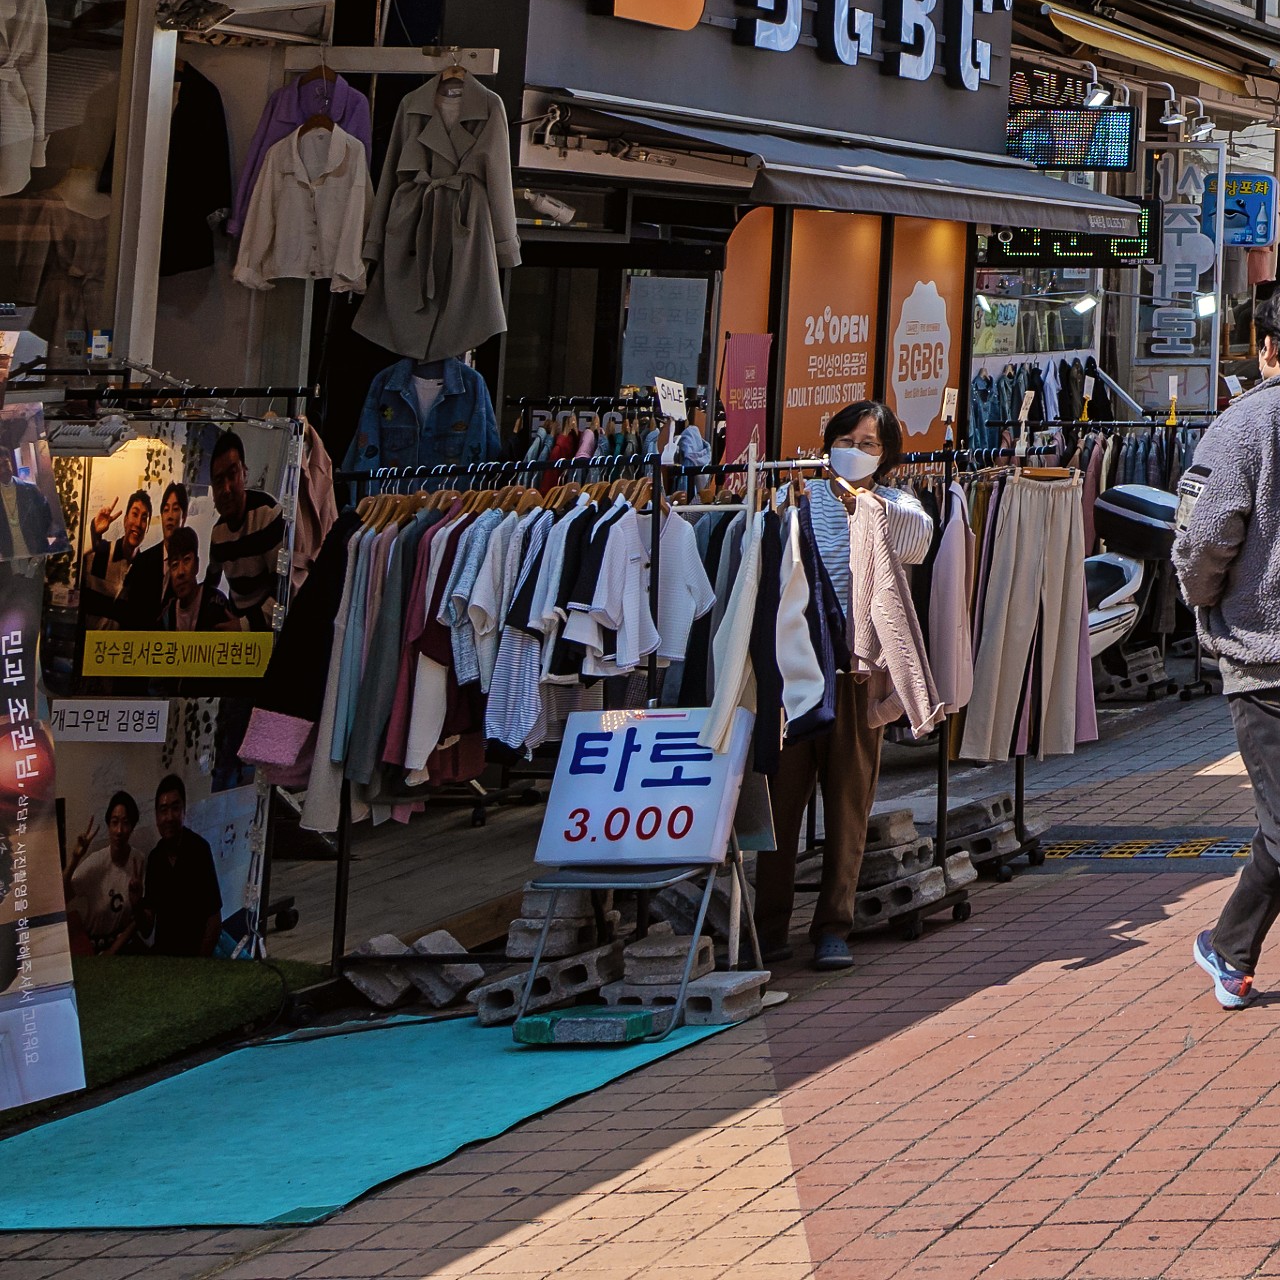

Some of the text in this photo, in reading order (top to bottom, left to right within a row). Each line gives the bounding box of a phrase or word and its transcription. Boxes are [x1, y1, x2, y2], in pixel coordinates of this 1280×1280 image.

[829, 315, 869, 344] OPEN
[807, 352, 868, 379] 무인성인용품점
[898, 341, 944, 382] BGBG
[659, 384, 685, 404] SALE
[787, 382, 866, 407] ADULT GOODS STORE
[94, 641, 262, 667] 장수원,서은광,VIINI(권현빈)
[51, 709, 160, 733] 개그우먼 김영희
[569, 727, 713, 793] 타로
[563, 805, 694, 843] 3.000
